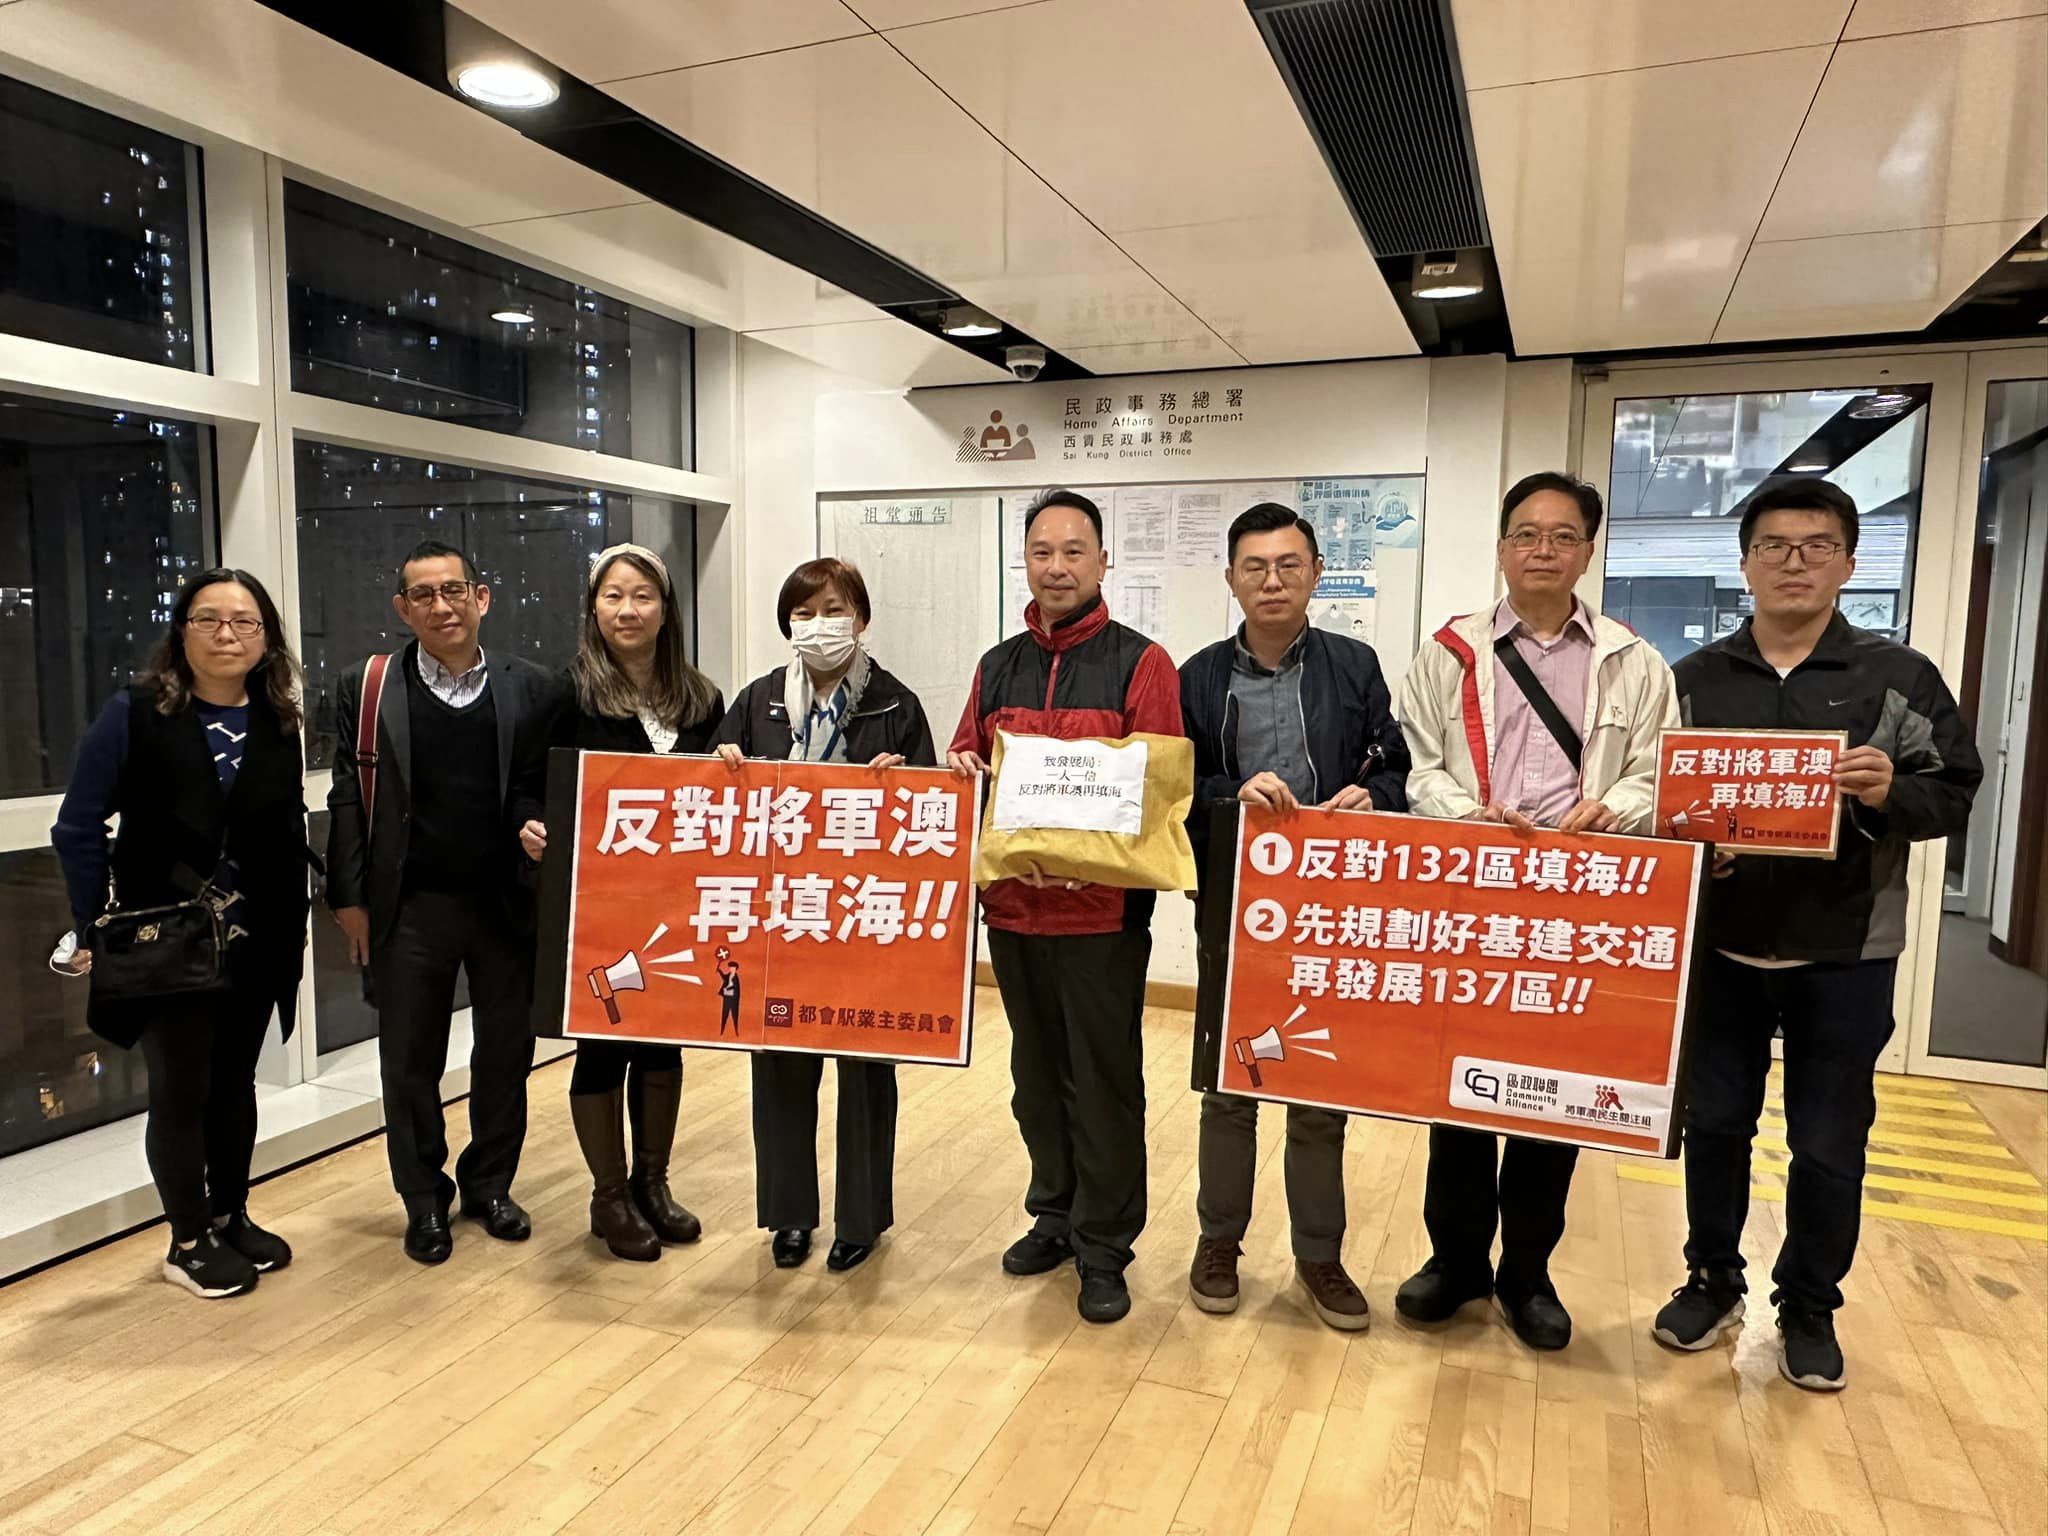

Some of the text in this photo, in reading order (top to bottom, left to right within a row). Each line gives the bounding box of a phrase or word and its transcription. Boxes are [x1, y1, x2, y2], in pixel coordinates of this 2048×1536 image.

[1064, 388, 1243, 416] 民政事務總署
[1064, 412, 1243, 430] Home Affairs Department
[1063, 447, 1192, 461] Sai Kung District Office
[1668, 747, 1833, 777] 反對將軍澳
[1708, 781, 1831, 811] 再填海!!
[597, 784, 959, 858] 反對將軍澳
[688, 872, 959, 946] 再填海!!
[1292, 902, 1677, 971] 先規劃好基建交通
[1287, 954, 1595, 1015] 再發展137區!!
[1505, 1099, 1544, 1111] Alliance
[1506, 1089, 1558, 1106] Community
